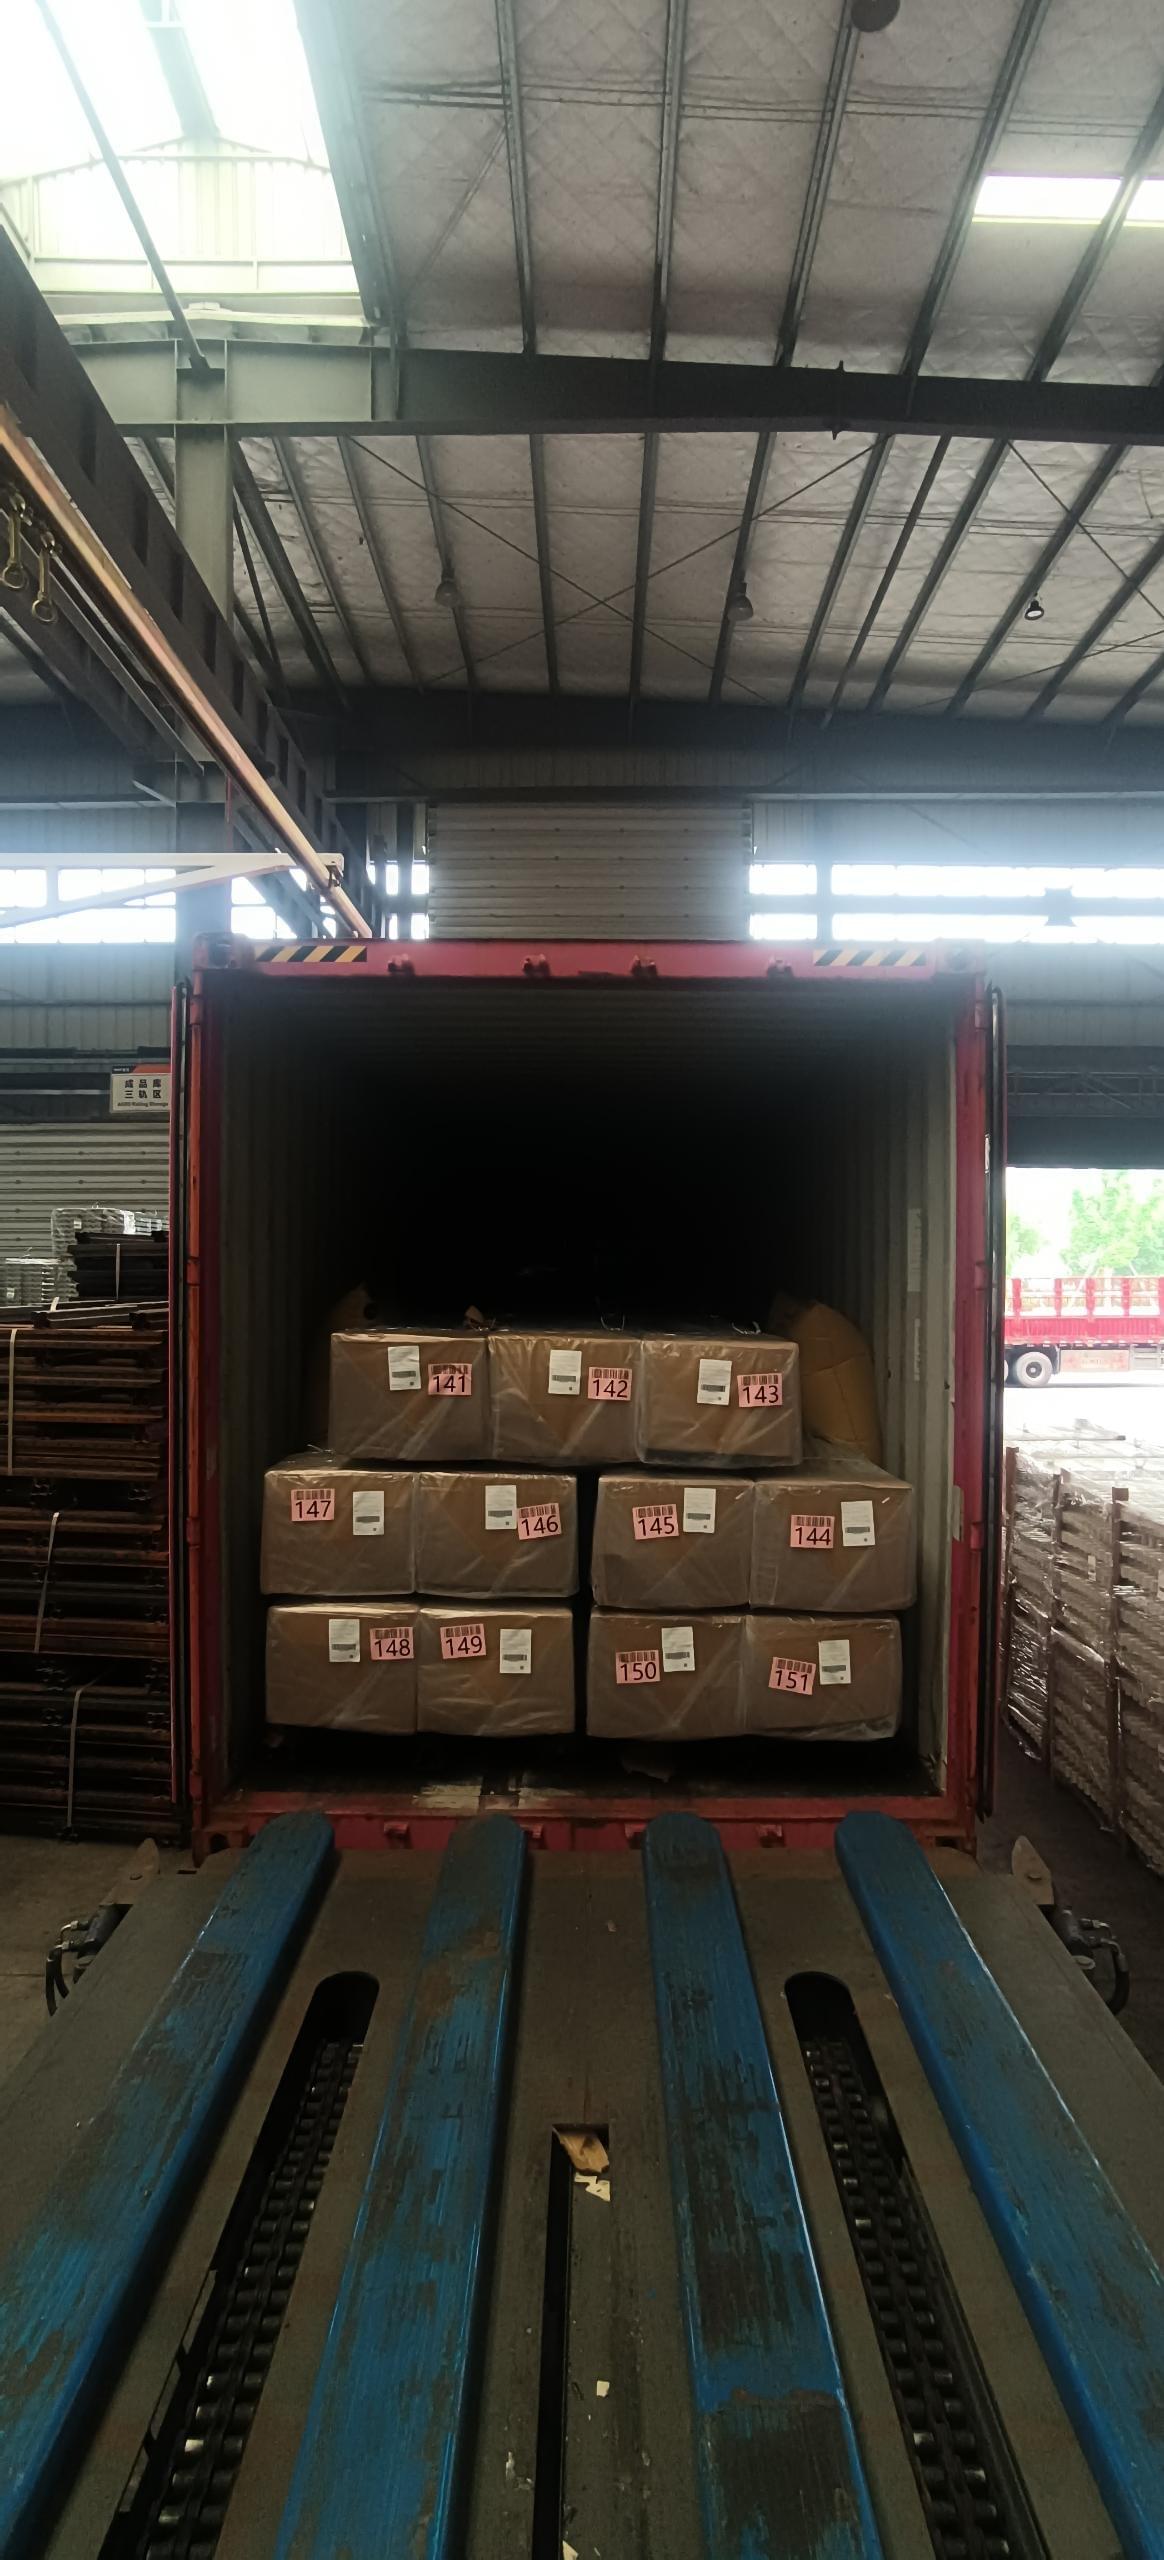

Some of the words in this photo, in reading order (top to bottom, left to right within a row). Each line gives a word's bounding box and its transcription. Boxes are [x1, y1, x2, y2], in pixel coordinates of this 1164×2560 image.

[433, 1374, 466, 1393] 141
[593, 1379, 629, 1399] 142
[743, 1385, 780, 1404] 143
[295, 1501, 332, 1518] 147
[522, 1516, 558, 1536] 146
[638, 1516, 675, 1536] 145
[795, 1527, 832, 1546] 144
[374, 1640, 411, 1657] 148
[446, 1636, 483, 1655] 149
[620, 1662, 657, 1681] 150
[776, 1669, 810, 1692] 151
